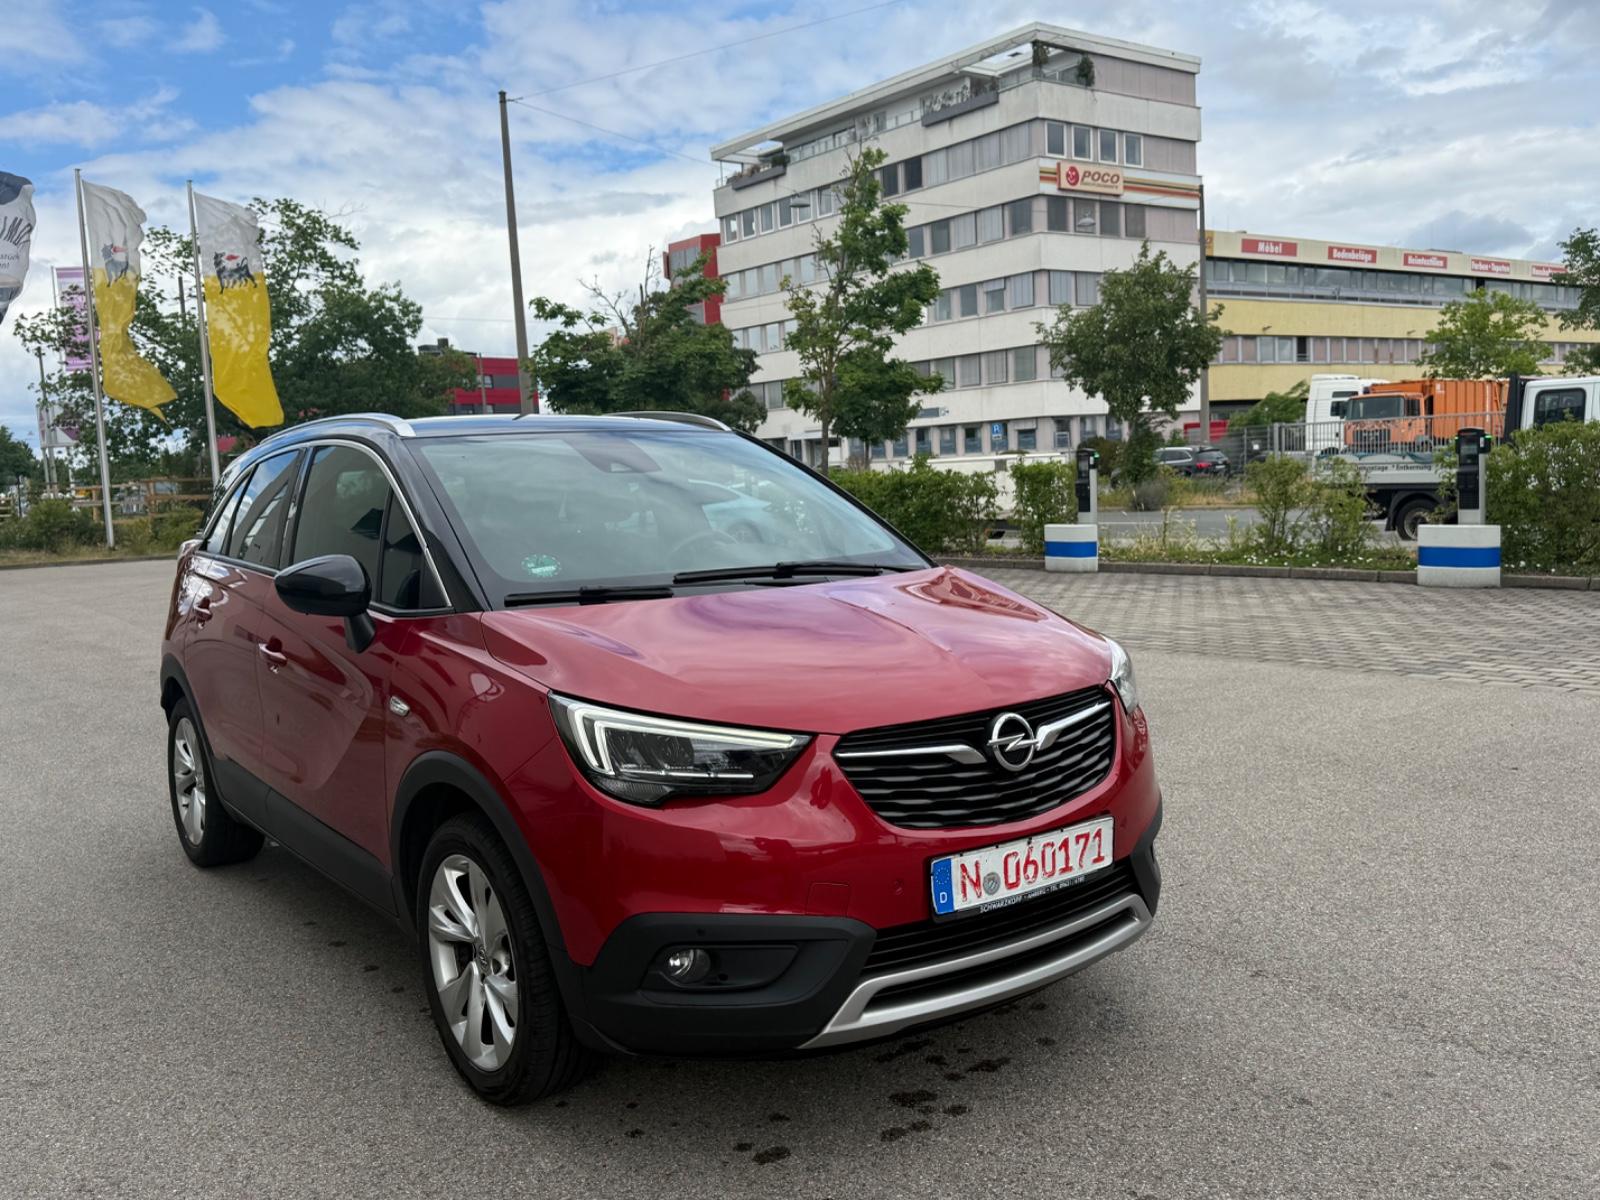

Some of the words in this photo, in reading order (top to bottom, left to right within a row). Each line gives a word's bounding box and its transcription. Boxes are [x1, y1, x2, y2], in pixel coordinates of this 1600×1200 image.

[1081, 170, 1120, 184] POCO
[1258, 241, 1283, 254] Möbel
[960, 860, 982, 902] N
[1003, 828, 1105, 890] 060171
[939, 892, 947, 903] D
